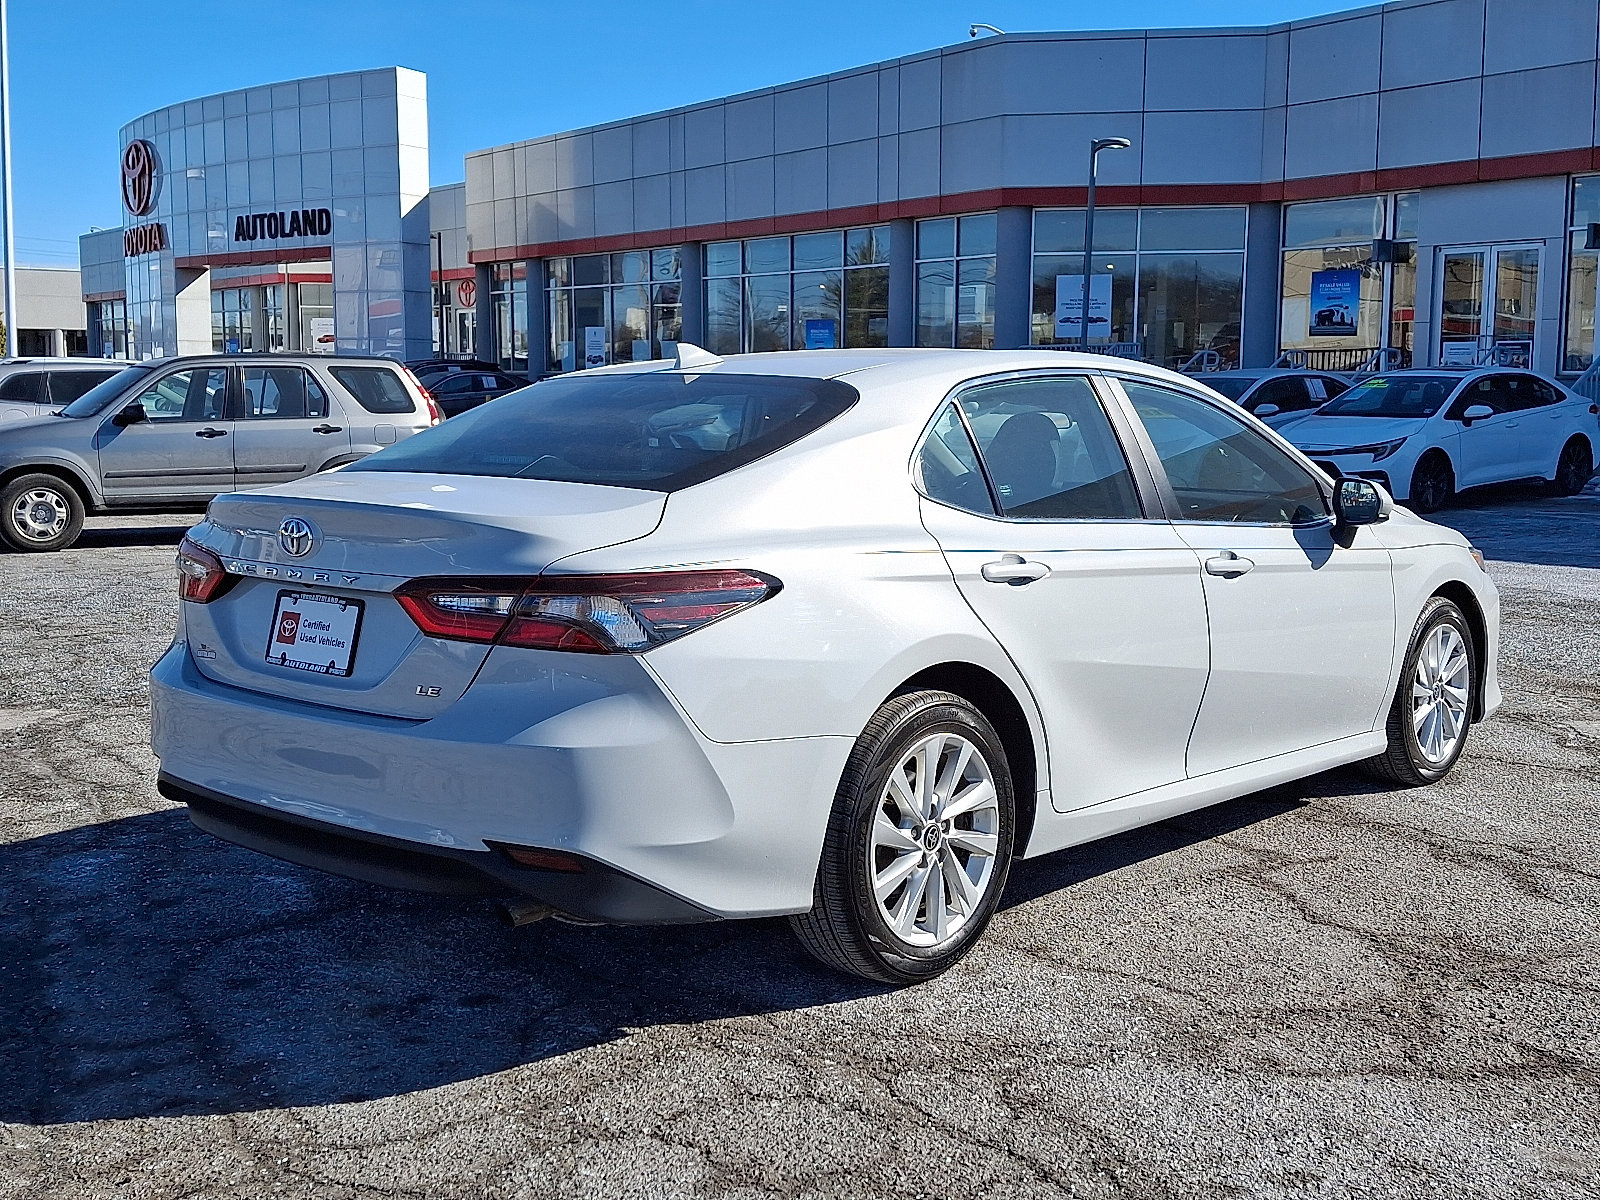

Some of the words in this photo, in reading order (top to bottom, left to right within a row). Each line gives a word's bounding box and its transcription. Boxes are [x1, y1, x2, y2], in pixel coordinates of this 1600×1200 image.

[235, 208, 331, 242] AUTOLAND
[243, 564, 361, 584] CAMRY
[302, 619, 331, 632] Certified
[300, 633, 317, 643] Used
[318, 635, 346, 648] Vehicles
[284, 660, 327, 673] AUTOLAND
[415, 685, 442, 697] LE
